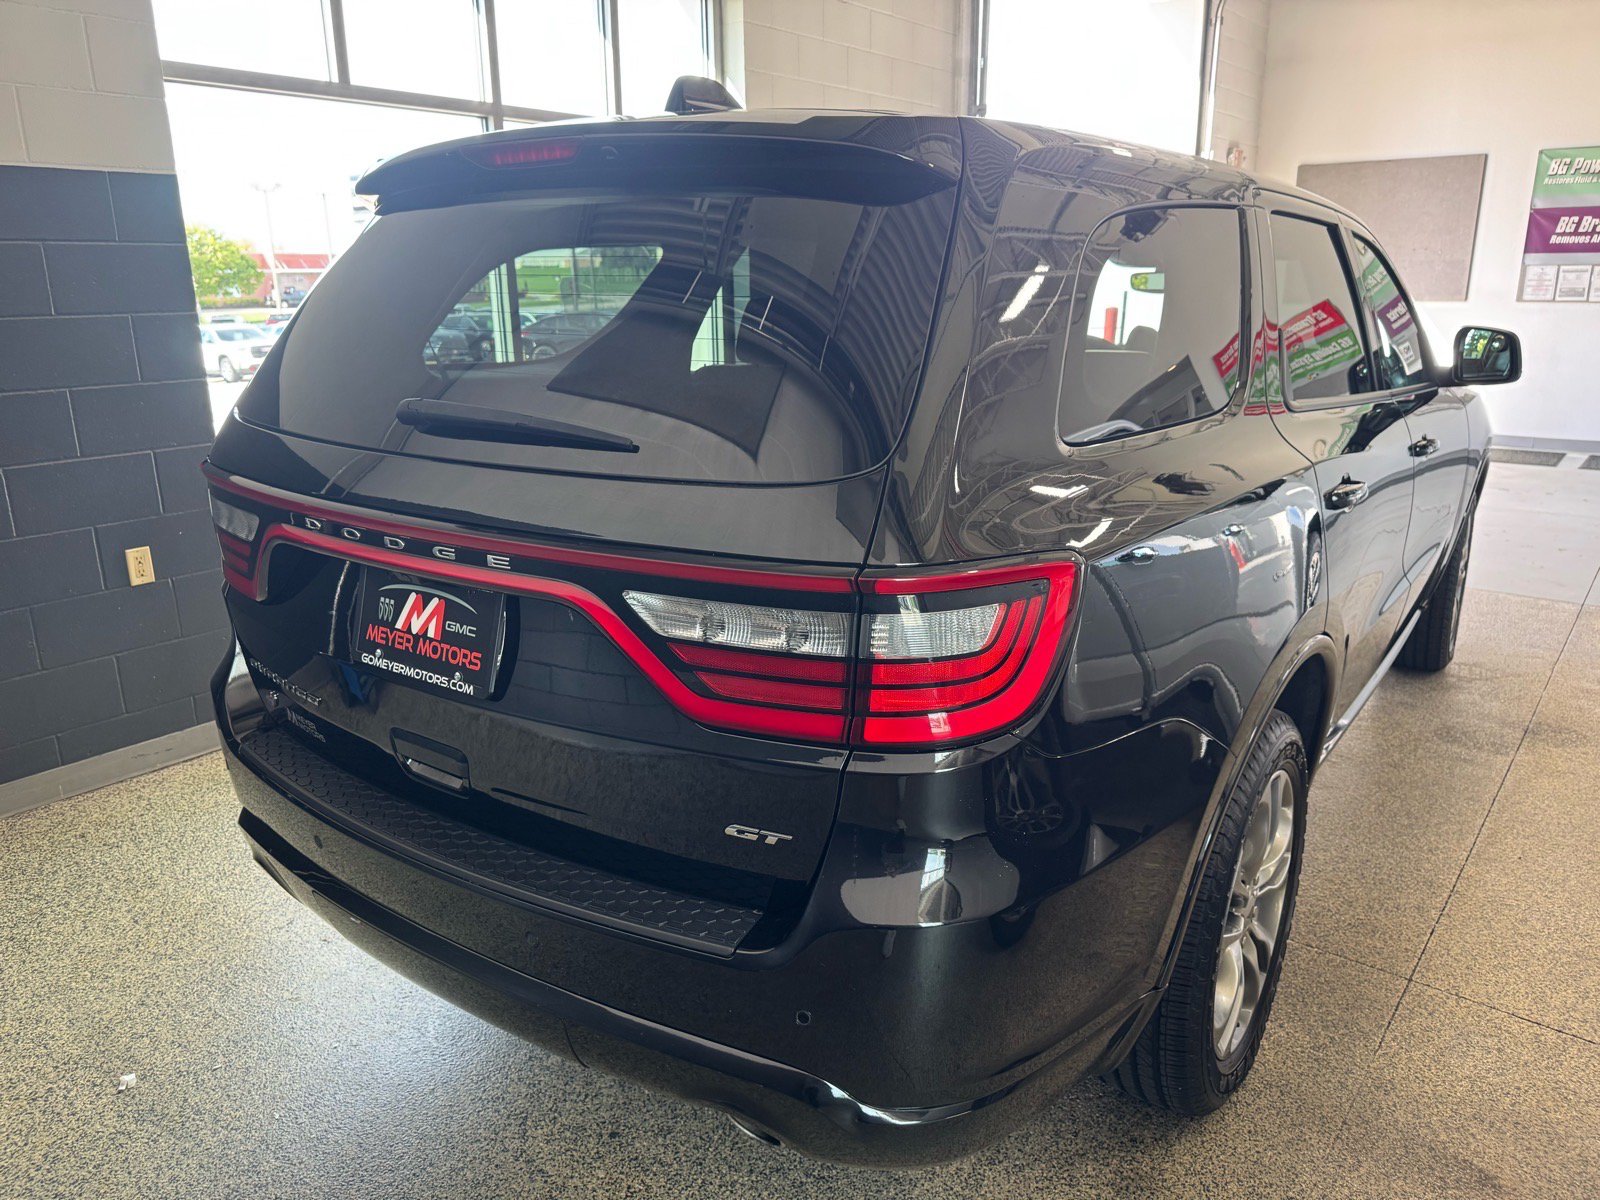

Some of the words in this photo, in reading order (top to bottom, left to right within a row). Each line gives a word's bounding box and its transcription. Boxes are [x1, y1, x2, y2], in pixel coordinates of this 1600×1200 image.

[1548, 158, 1571, 175] BG
[1555, 215, 1579, 233] BG
[1549, 234, 1591, 244] Removes
[304, 517, 511, 570] DODGE
[445, 620, 477, 637] GMC
[366, 623, 414, 653] MEYER
[416, 637, 482, 671] MOTORS
[361, 653, 474, 695] GOMEYERMOTORS.COM
[724, 824, 793, 845] GT
